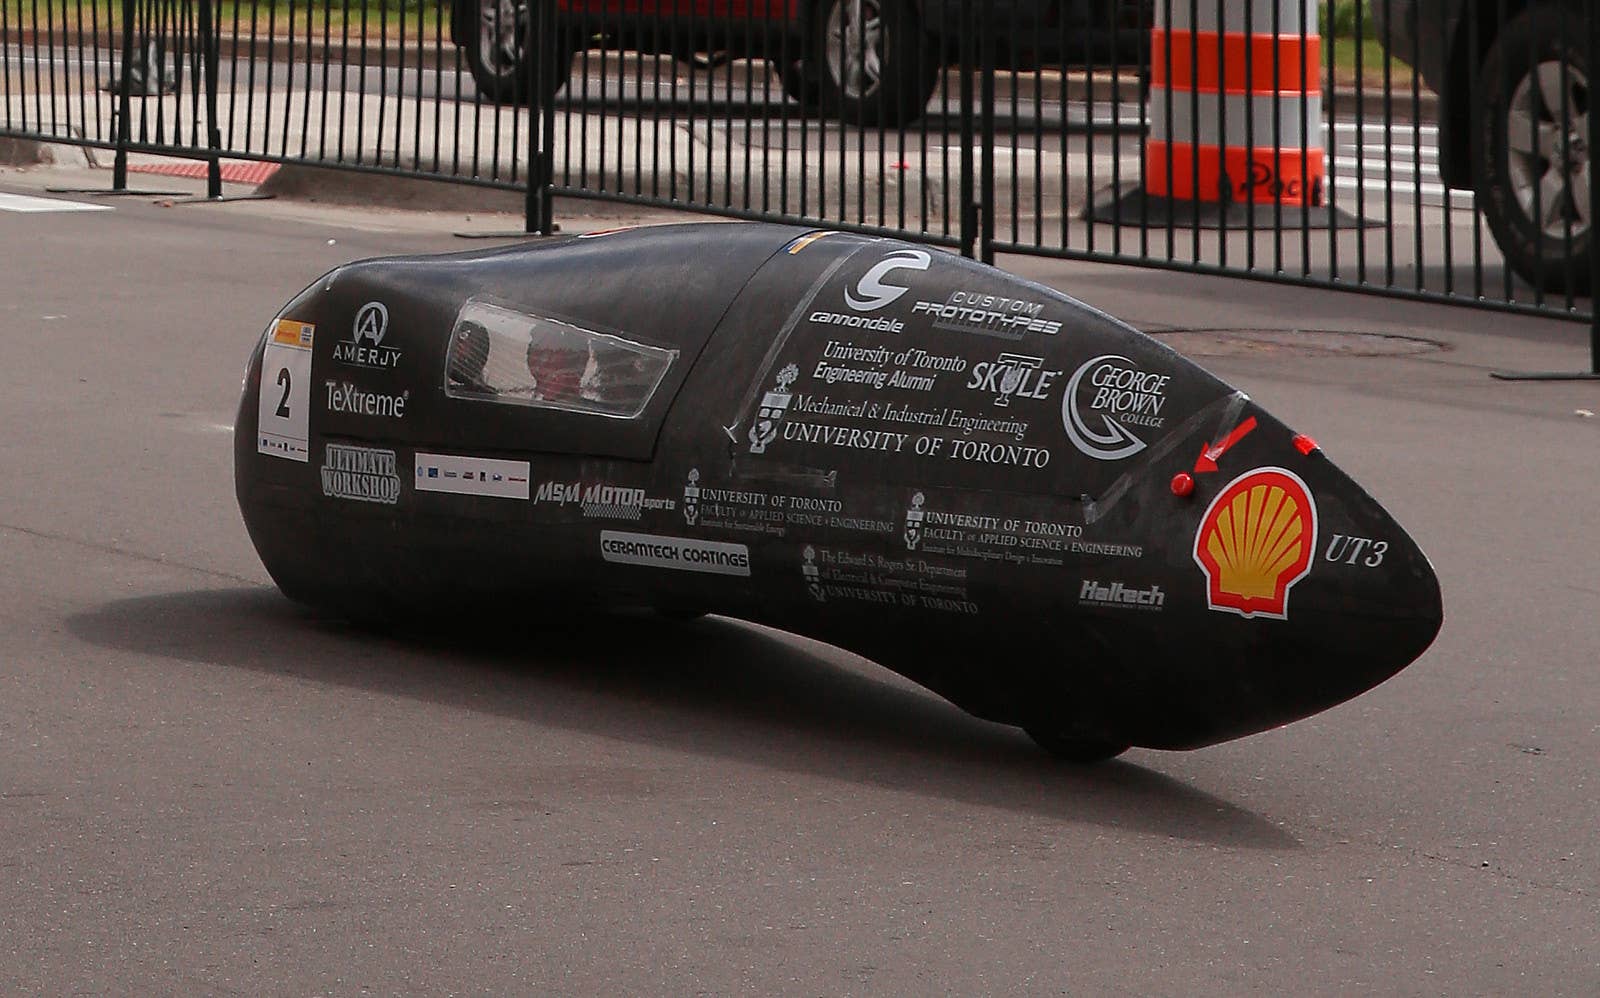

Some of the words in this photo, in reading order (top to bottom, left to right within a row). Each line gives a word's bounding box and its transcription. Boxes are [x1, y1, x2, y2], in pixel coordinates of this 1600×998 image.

[952, 291, 1044, 314] CUSTOM
[809, 311, 904, 334] cannondale
[912, 301, 1063, 335] PROTOTYPES
[333, 346, 402, 368] AMERJY
[823, 340, 893, 367] University
[894, 348, 915, 367] of
[912, 350, 967, 373] Toronto
[813, 361, 887, 389] Engineering
[888, 370, 937, 392] Alumni
[1091, 364, 1170, 395] GEORGE
[275, 367, 292, 419] 2
[1091, 387, 1165, 415] BROWN
[793, 394, 867, 419] Mechanical
[868, 403, 879, 418] &
[882, 403, 945, 428] Industrial
[948, 410, 1028, 440] Engineering
[1121, 412, 1165, 428] COLLEGE
[326, 445, 396, 475] ULTIMATE
[783, 421, 910, 453] UNIVERSITY
[915, 436, 943, 457] OF
[950, 439, 1050, 469] TORONTO
[321, 466, 400, 503] WORKSHOP
[534, 481, 581, 507] MSM
[702, 488, 768, 506] UNIVERSITY
[771, 495, 786, 508] OF
[789, 496, 843, 513] TORONTO
[749, 509, 784, 523] APPLIED
[787, 513, 823, 527] SCIENCE
[830, 518, 894, 533] ENGINEERING
[926, 511, 1001, 530] UNIVERSITY
[1003, 519, 1020, 532] OF
[1025, 521, 1083, 538] TORONTO
[602, 539, 679, 561] CERAMTECH
[682, 547, 748, 568] COATINGS
[923, 527, 966, 542] FACULTY
[977, 532, 1018, 547] APPLIED
[1020, 536, 1062, 551] SCIENCE
[1071, 542, 1143, 558] ENGINEERING
[1325, 534, 1389, 568] UT3
[826, 584, 898, 605] UNIVERSITY
[902, 594, 918, 607] OF
[921, 596, 979, 615] TORONTO
[1080, 580, 1165, 606] Haltech
